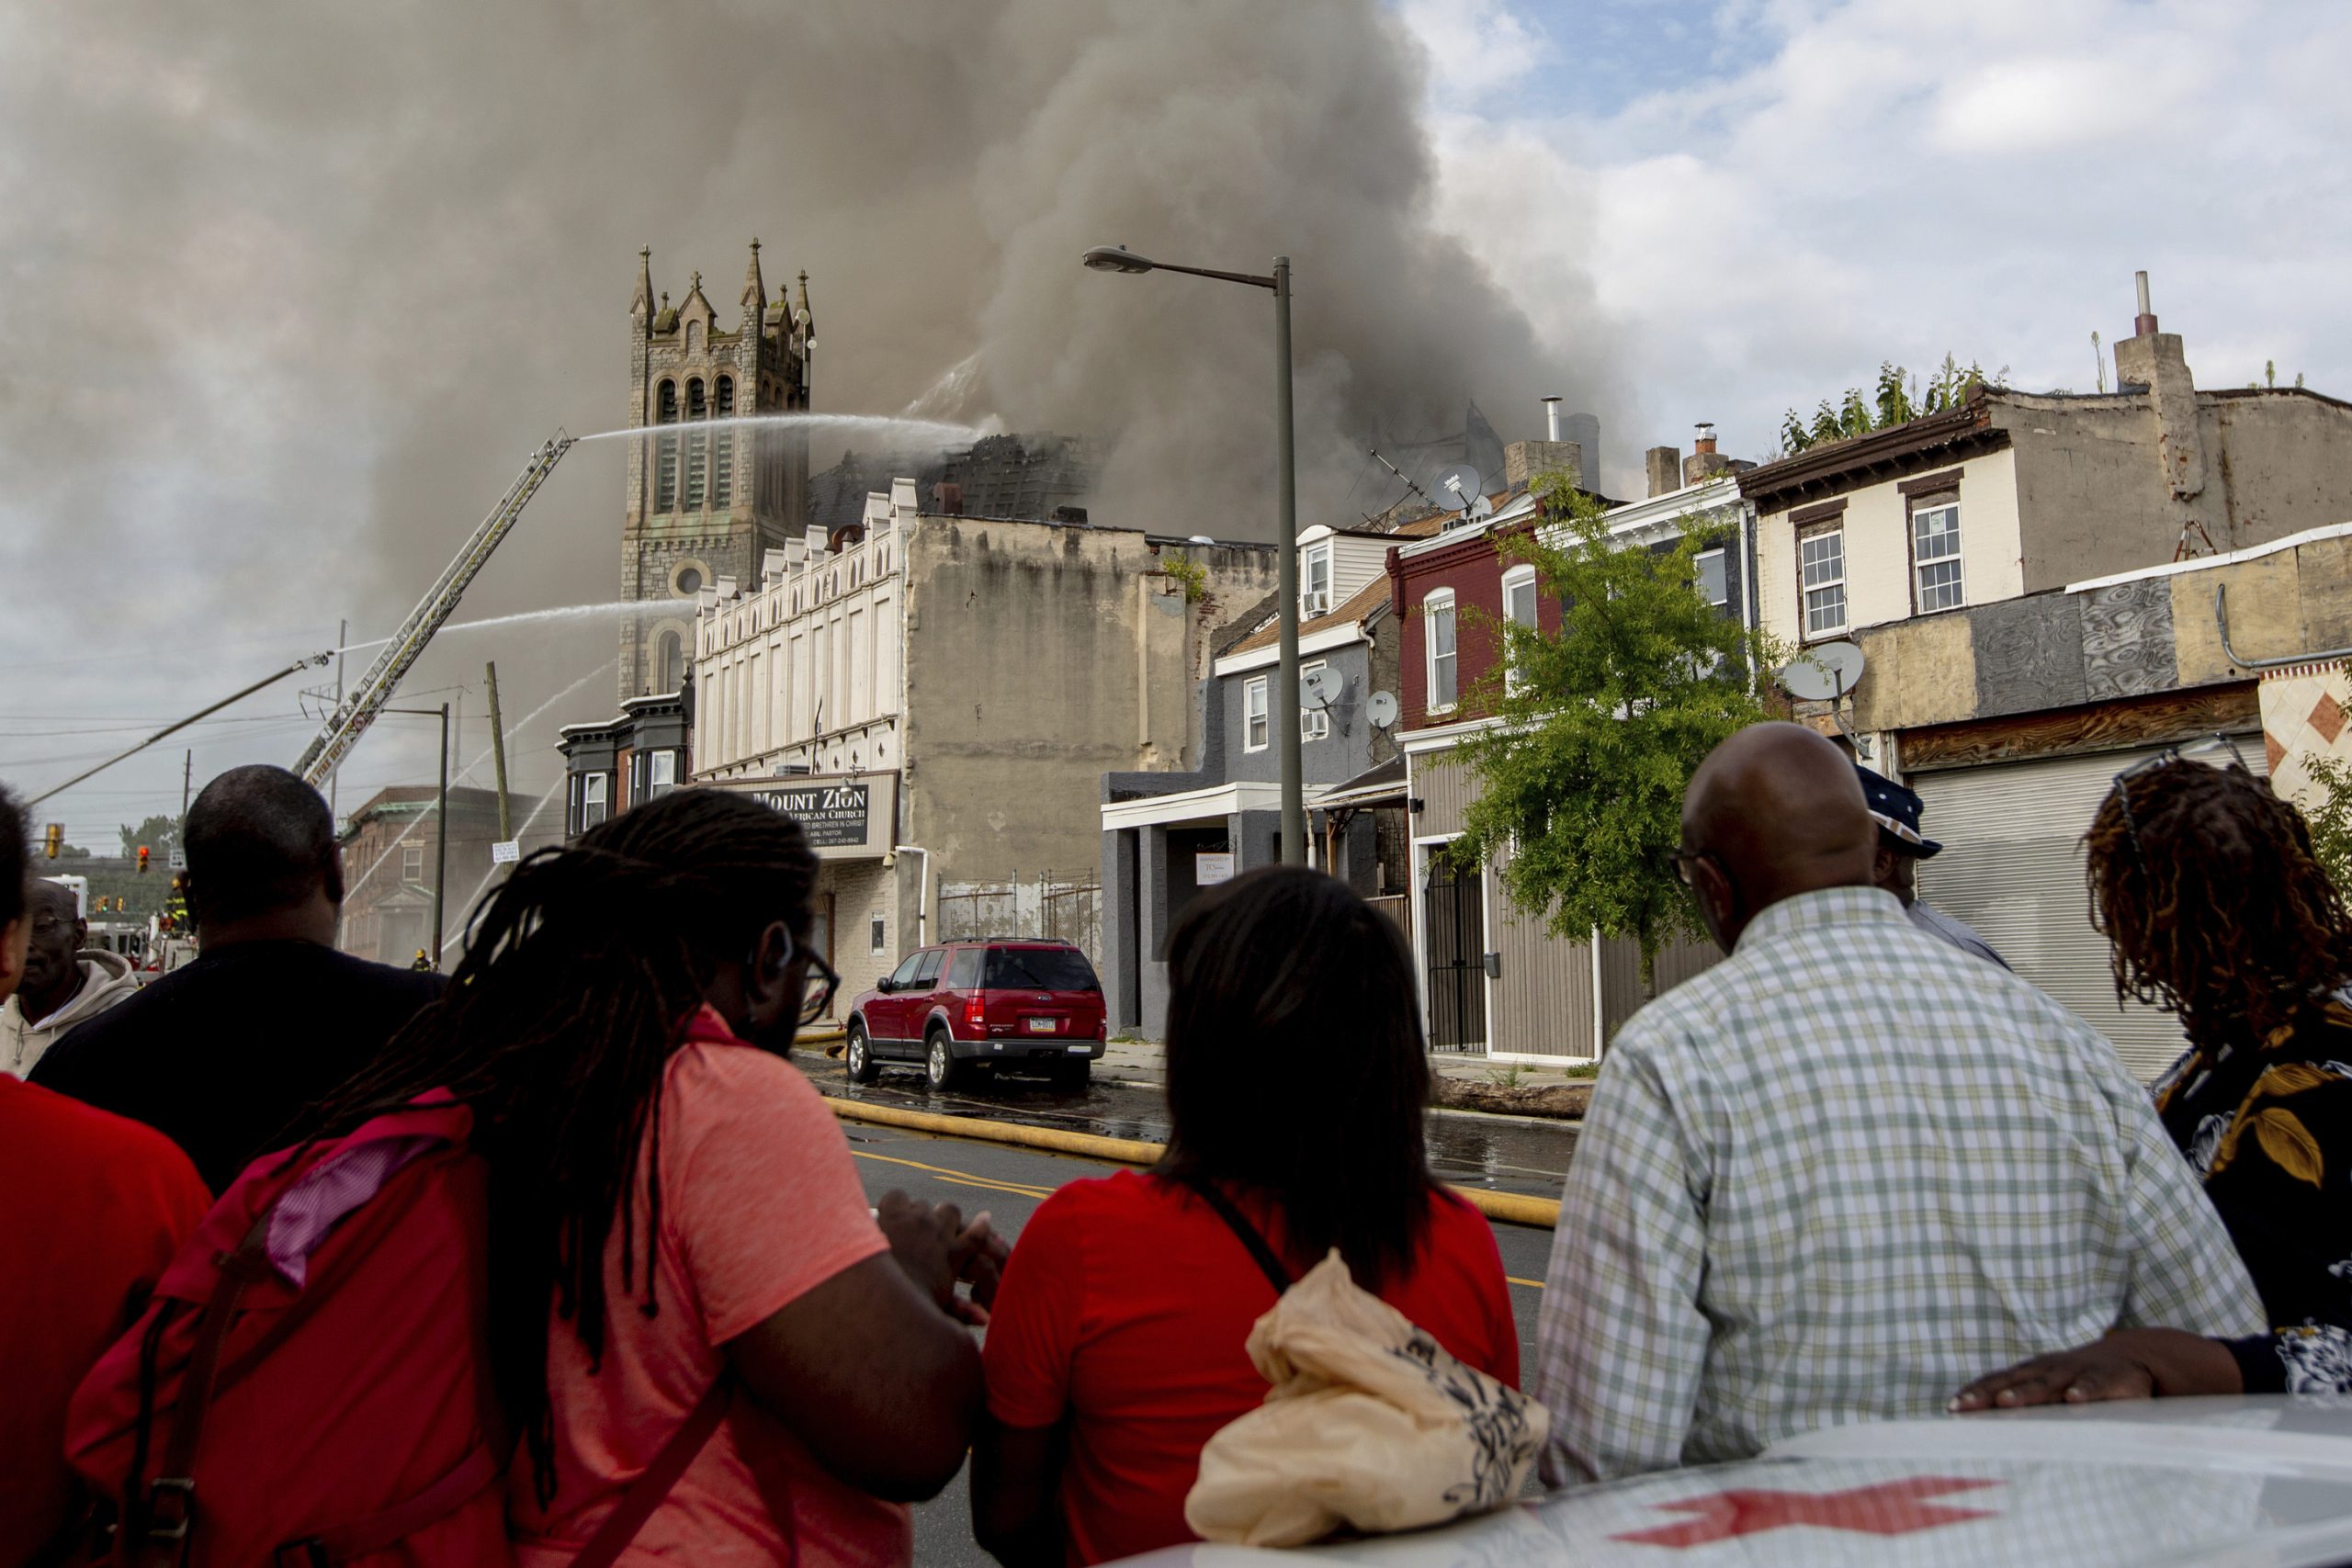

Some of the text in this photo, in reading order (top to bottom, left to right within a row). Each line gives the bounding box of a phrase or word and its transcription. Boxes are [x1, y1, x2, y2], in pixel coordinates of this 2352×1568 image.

[315, 759, 332, 779] FIRE
[753, 793, 817, 811] MOUNT
[829, 810, 865, 819] CHURCH
[811, 821, 839, 829] BRETHREN
